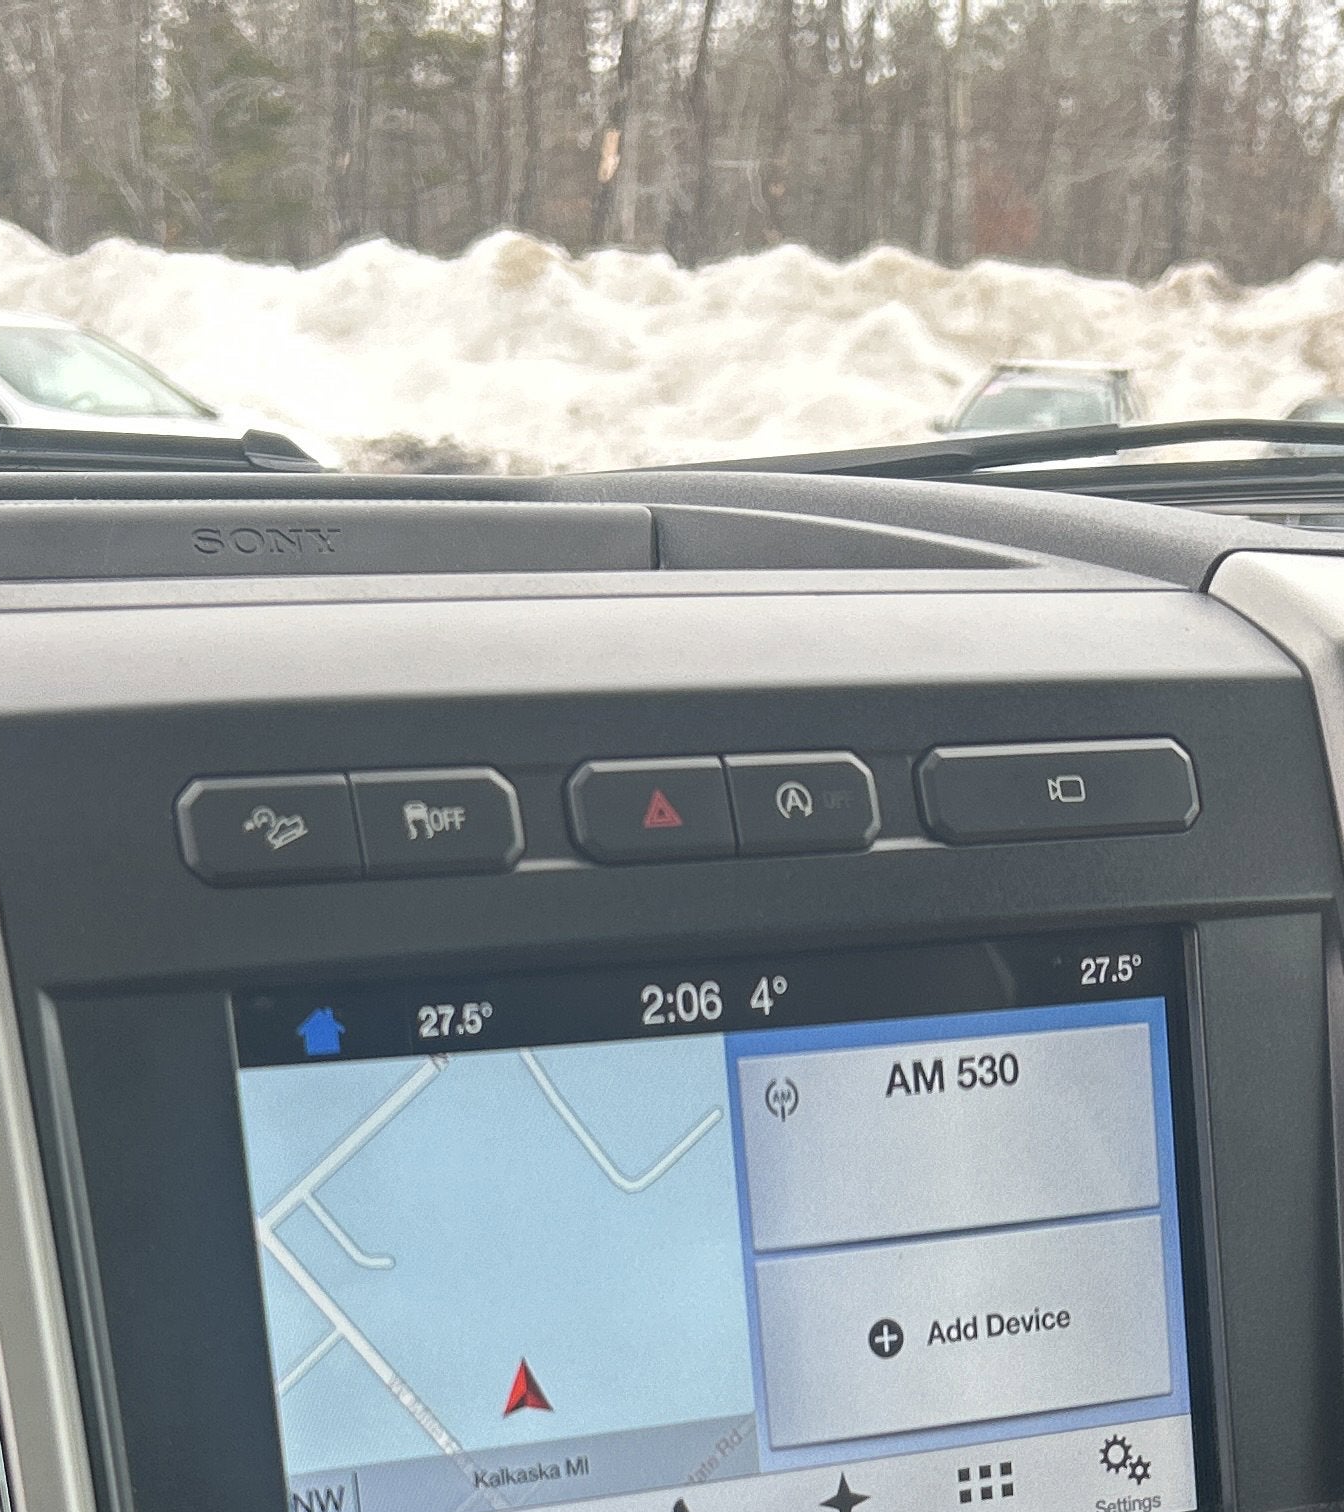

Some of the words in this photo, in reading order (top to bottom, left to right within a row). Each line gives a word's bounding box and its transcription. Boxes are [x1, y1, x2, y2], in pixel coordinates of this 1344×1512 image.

[192, 527, 341, 555] SONY
[429, 806, 466, 832] OFF
[1080, 953, 1143, 986] 27.5°
[640, 979, 723, 1025] 2:06
[885, 1058, 946, 1098] AM
[956, 1051, 1020, 1090] 530
[927, 1315, 979, 1346] Add
[986, 1307, 1072, 1338] Device
[472, 1463, 562, 1490] Kalkaska
[565, 1456, 591, 1477] MI
